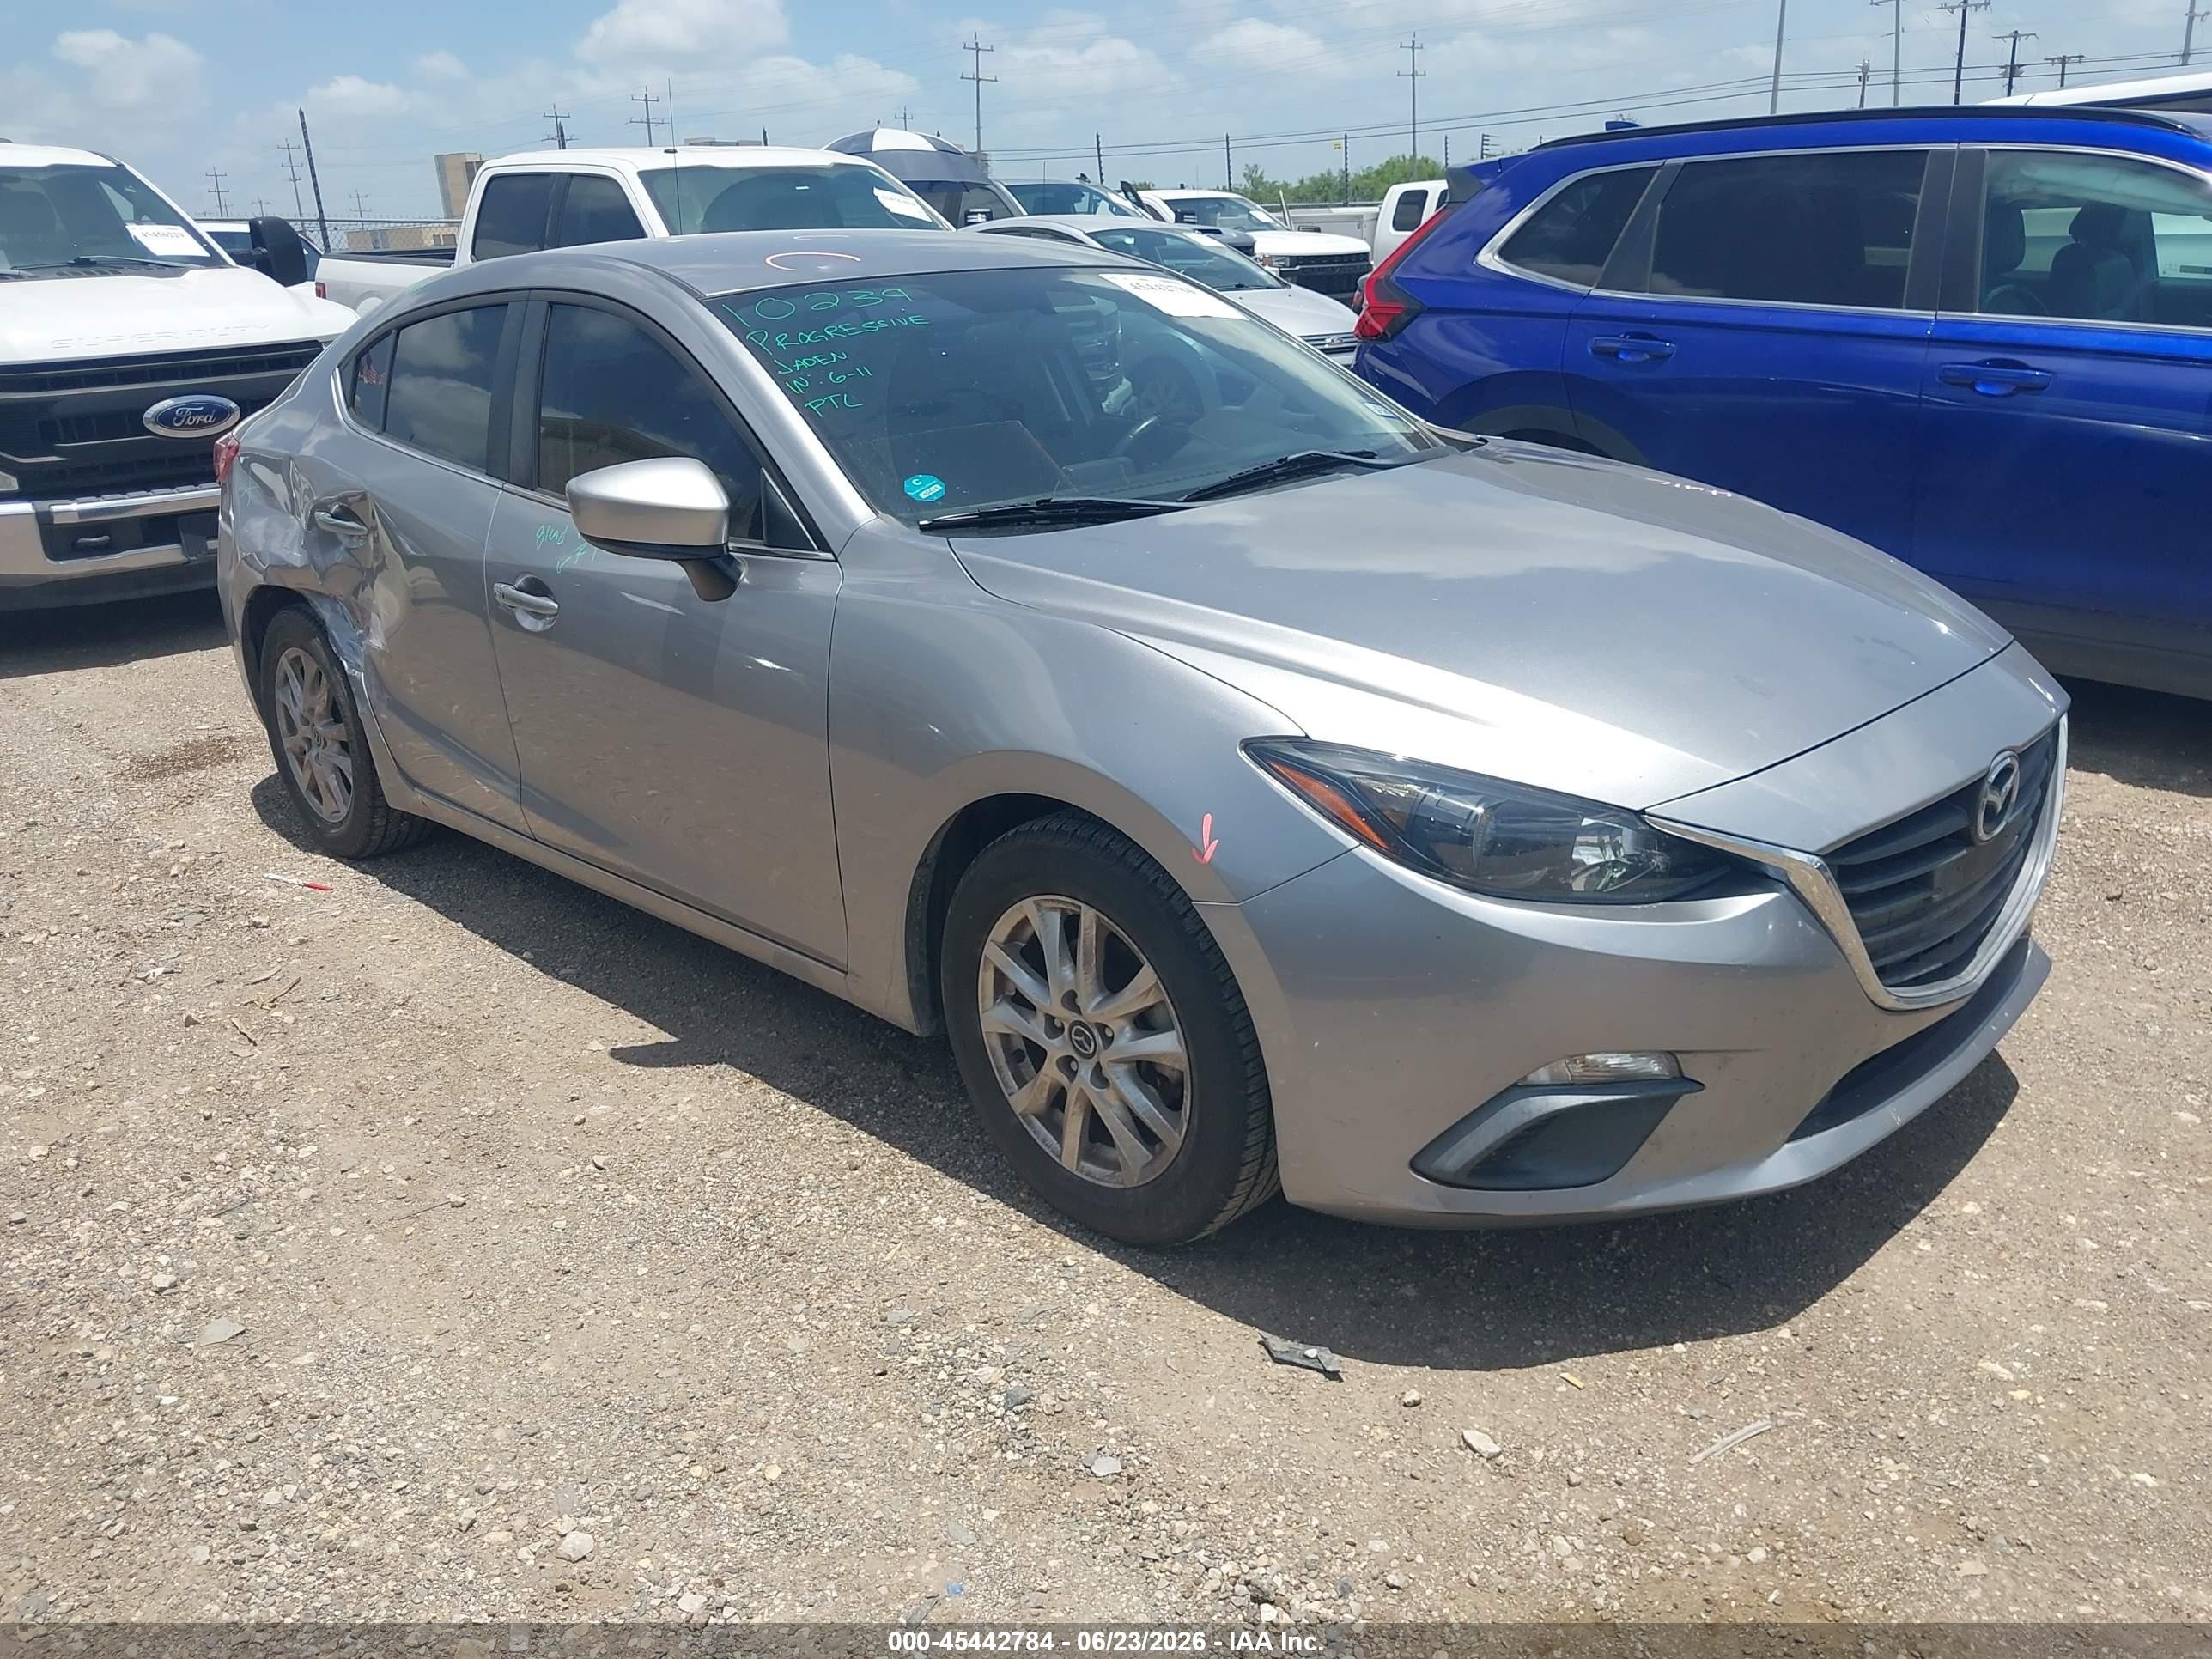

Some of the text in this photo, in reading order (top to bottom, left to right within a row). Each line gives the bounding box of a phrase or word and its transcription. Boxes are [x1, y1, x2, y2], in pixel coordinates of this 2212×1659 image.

[722, 289, 913, 327] 10239
[746, 315, 930, 355] PROGRESSIVE
[774, 352, 847, 374] JADEN
[829, 366, 872, 384] 6-11
[173, 406, 216, 427] Ford
[804, 393, 863, 417] PTL
